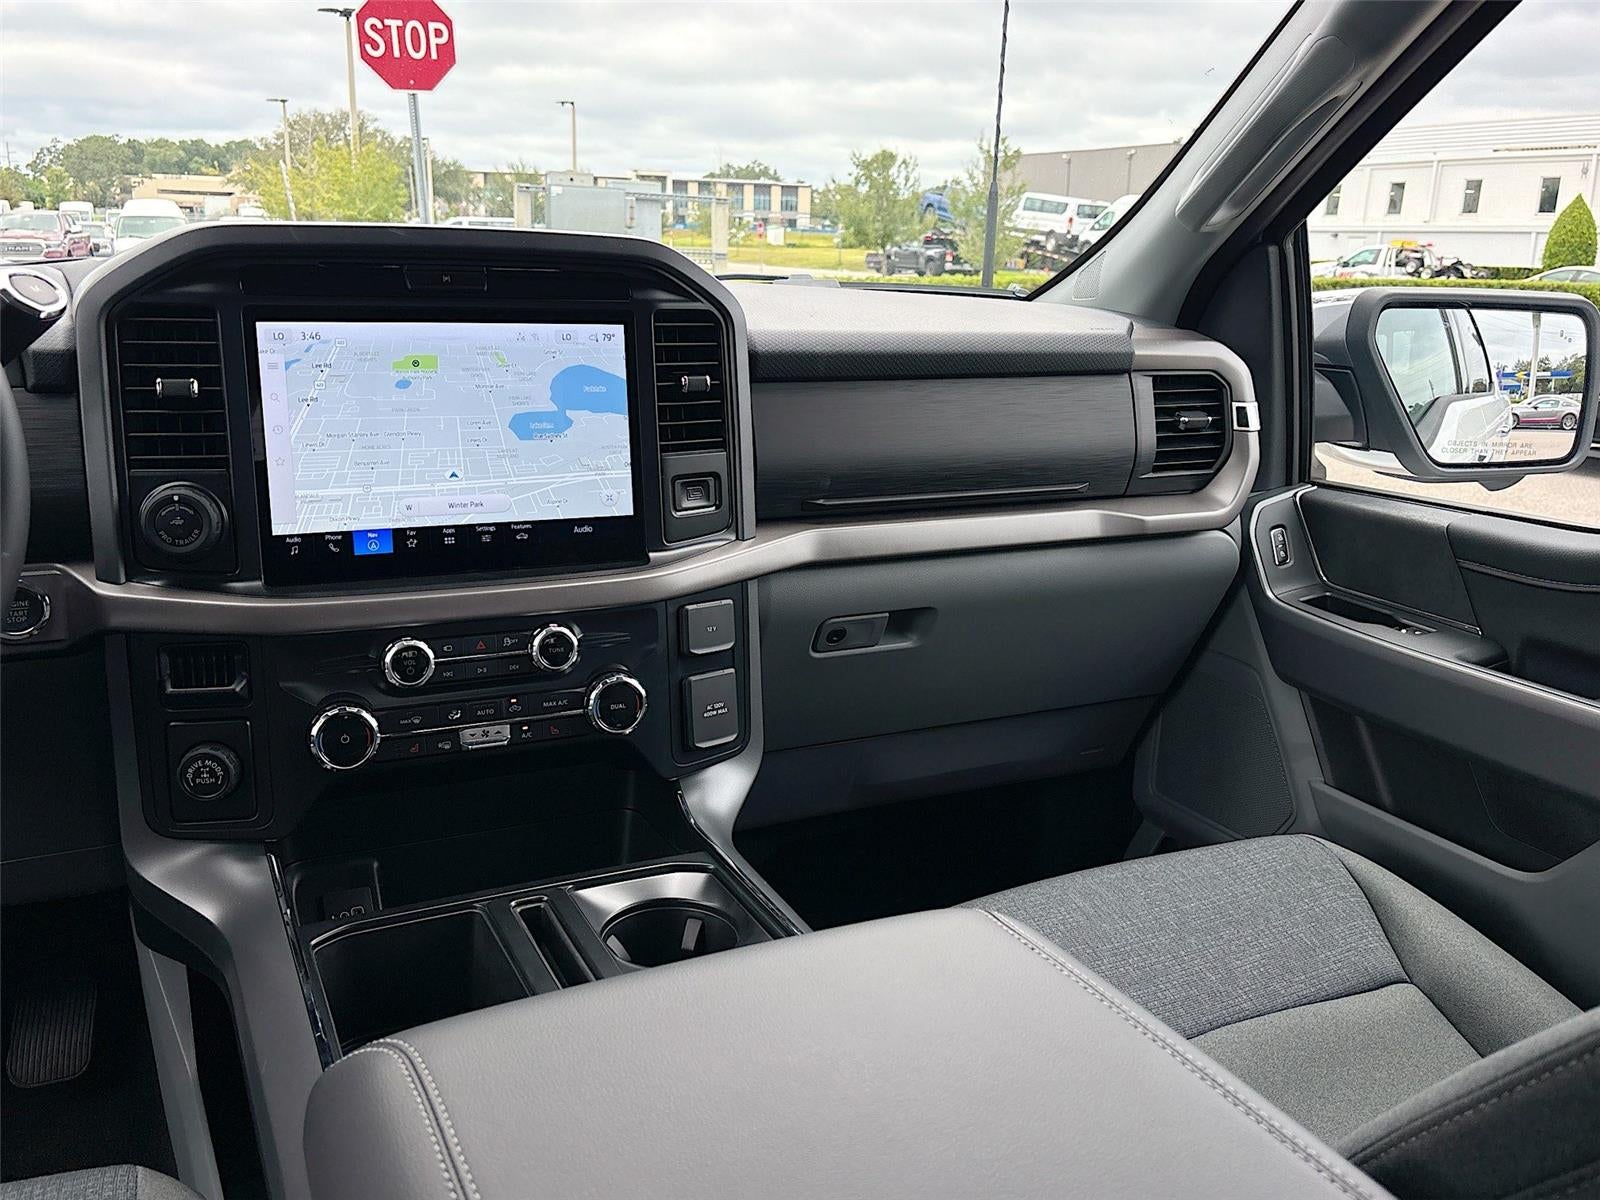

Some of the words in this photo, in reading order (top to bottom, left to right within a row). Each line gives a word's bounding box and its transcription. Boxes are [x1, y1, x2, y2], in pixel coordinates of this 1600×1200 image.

[363, 16, 450, 60] STOP
[272, 332, 284, 340] LO
[300, 331, 321, 341] 3:46
[562, 333, 572, 341] LO
[602, 333, 616, 342] 79°
[574, 525, 593, 534] Audio
[158, 530, 172, 544] PRO
[174, 529, 200, 546] TRAILER
[610, 702, 627, 710] DUAL
[186, 760, 203, 779] DRIVE
[204, 760, 224, 776] MODE
